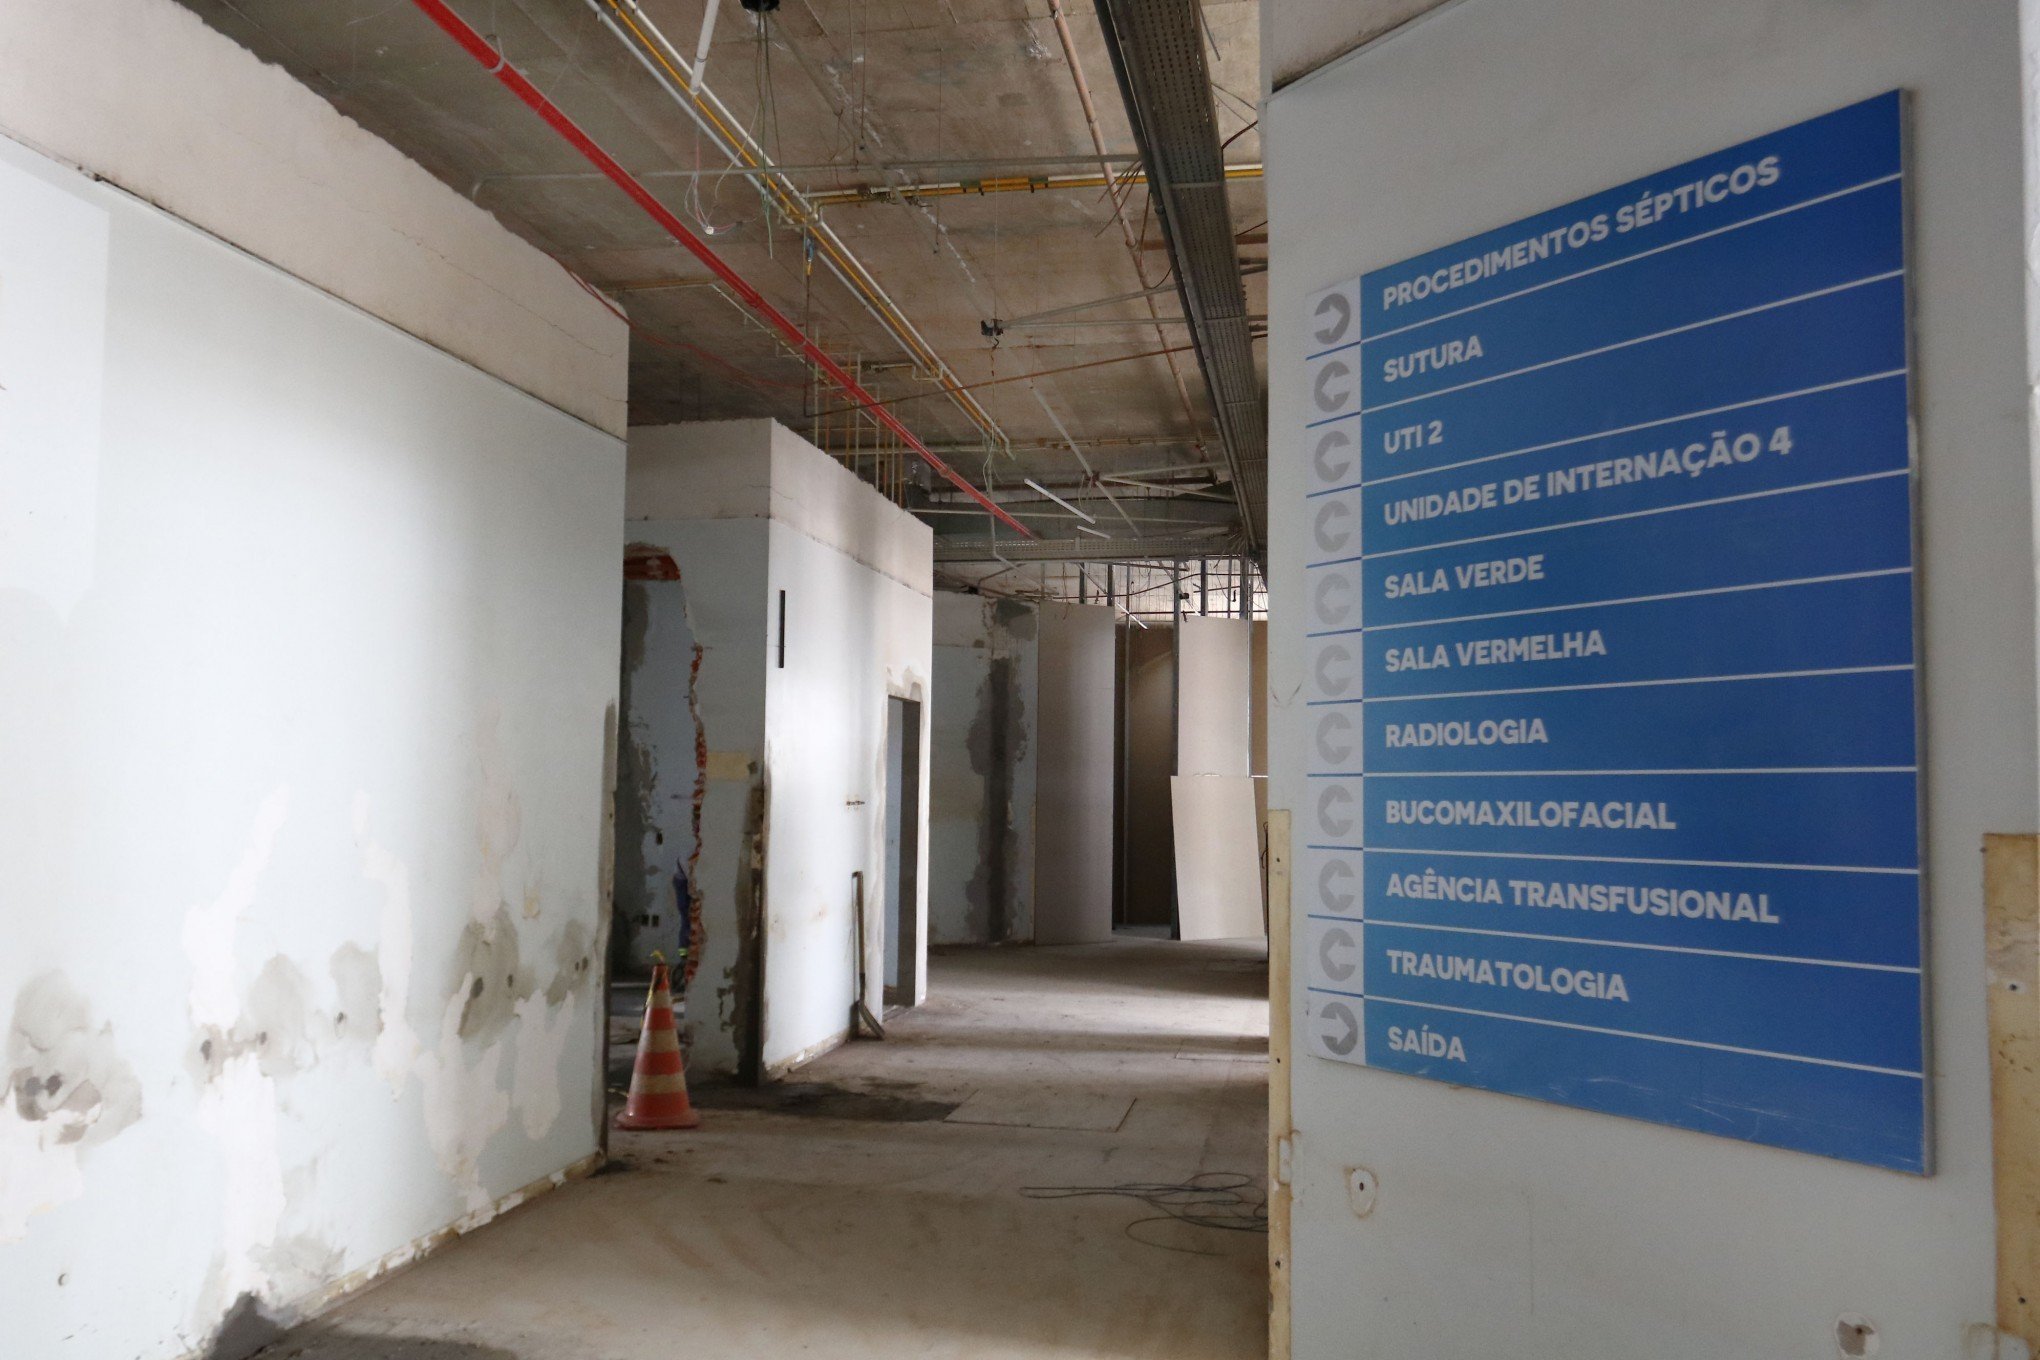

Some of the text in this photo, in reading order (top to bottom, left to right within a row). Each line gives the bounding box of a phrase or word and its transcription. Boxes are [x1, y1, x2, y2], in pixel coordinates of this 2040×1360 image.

[1382, 155, 1780, 311] PROCEDIMENTOS SÉPTICOS
[1383, 334, 1485, 383] SUTURA
[1383, 420, 1444, 455] UTI 2
[1383, 425, 1794, 527] UNIDADE DE INTERNAÇÃO 4
[1384, 554, 1545, 599] SALA VERDE
[1384, 630, 1607, 672] SALA VERMELHA
[1385, 718, 1549, 751] RADIOLOGIA
[1385, 799, 1677, 830] BUCOMAXILOFACIAL
[1385, 867, 1779, 924] AGÊNCIA TRANSFUSIONAL
[1386, 949, 1629, 1002] TRAUMATOLOGIA
[1387, 1023, 1467, 1062] SAÍDA
